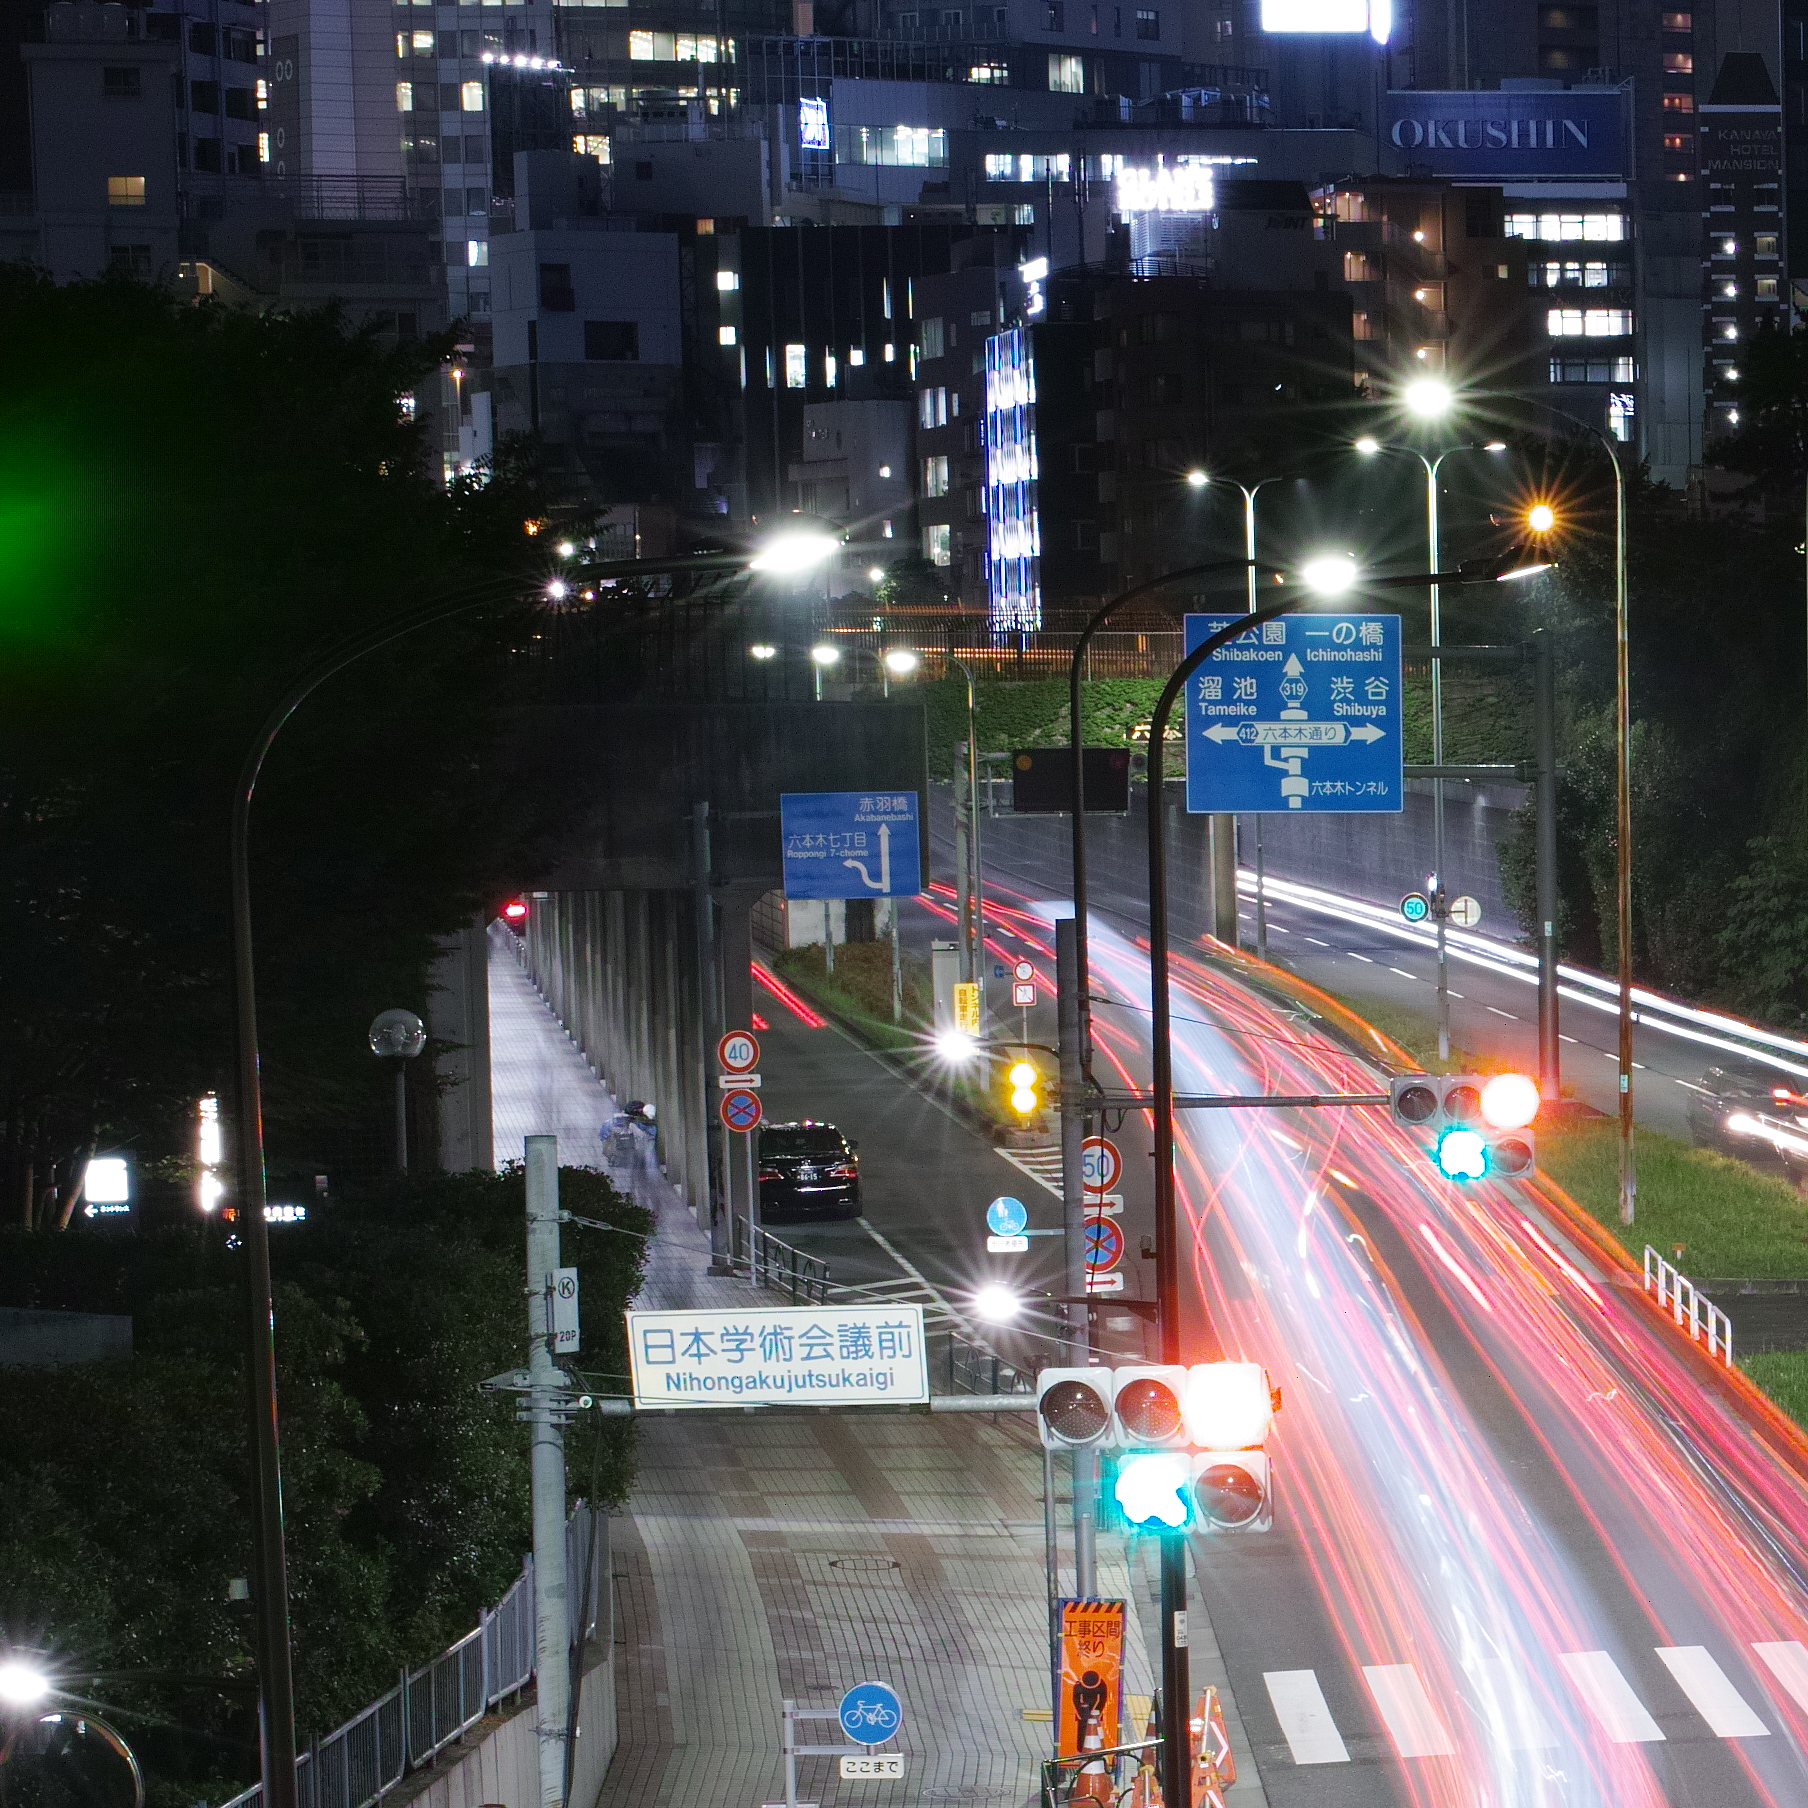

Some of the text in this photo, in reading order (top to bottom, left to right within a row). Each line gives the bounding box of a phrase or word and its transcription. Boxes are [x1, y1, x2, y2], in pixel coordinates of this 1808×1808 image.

[1391, 118, 1591, 149] OKUSHIN
[1718, 129, 1778, 141] KANAYA
[1730, 144, 1778, 155] HOTEL
[1707, 159, 1779, 170] MANSION
[1305, 621, 1384, 646] 一の橋
[1212, 648, 1283, 662] Shibakoen
[1306, 648, 1383, 662] Ichinohashi
[1198, 676, 1258, 700] 溜池
[1283, 682, 1304, 696] 319
[1330, 675, 1390, 700] 渋谷
[1198, 702, 1258, 716] Tameike
[1333, 702, 1387, 718] Shibuya
[1238, 727, 1257, 740] 412
[1262, 726, 1338, 741] 六本木通り
[1311, 781, 1389, 796] 六本木トンネル
[859, 796, 908, 812] 赤羽橋
[854, 814, 914, 822] Akabanebashi
[788, 831, 867, 849] 六本木七丁目
[786, 848, 869, 859] Roppongi 7-chome
[1406, 901, 1423, 915] 50
[728, 1043, 750, 1061] 40
[1082, 1154, 1110, 1178] 50
[559, 1329, 577, 1342] 20P
[643, 1320, 913, 1365] 日本学術会議前
[665, 1367, 896, 1394] Nihongakujutsukaigi
[1064, 1619, 1121, 1639] 工事区間
[1077, 1640, 1105, 1658] 終り
[846, 1761, 899, 1773] ここまで
